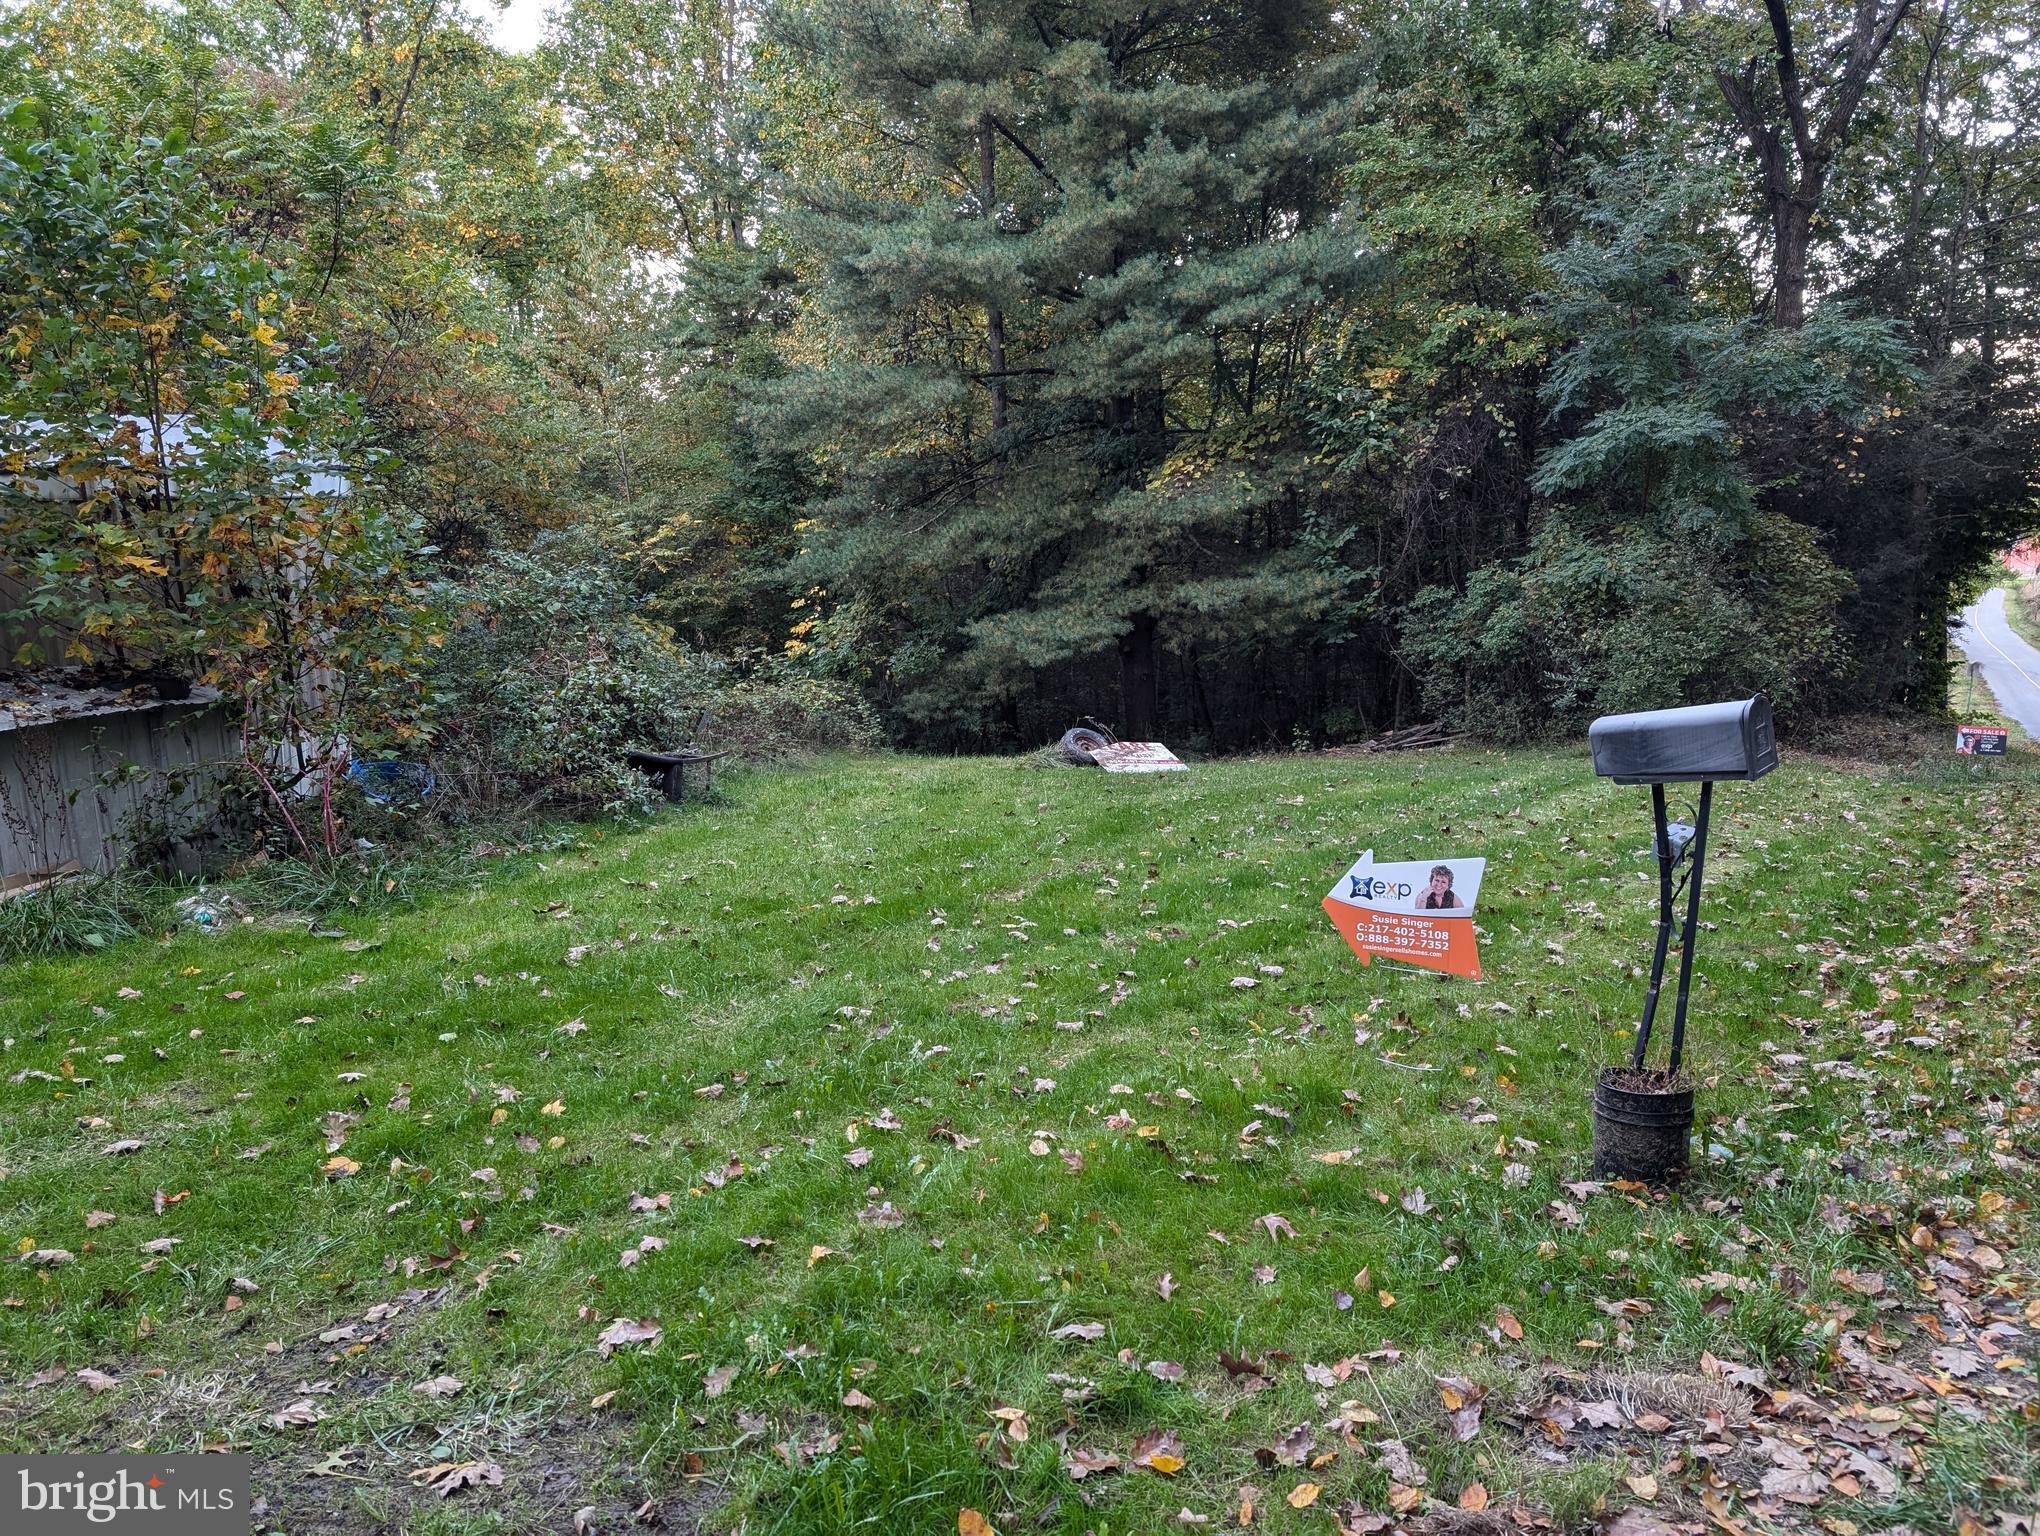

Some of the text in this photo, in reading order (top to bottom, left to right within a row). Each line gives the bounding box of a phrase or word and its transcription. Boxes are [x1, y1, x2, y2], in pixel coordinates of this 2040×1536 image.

[1373, 881, 1412, 900] exp
[1372, 914, 1434, 929] Susie Singer
[1357, 922, 1449, 941] C:217-402-5108
[1356, 932, 1449, 951] O:888-397-7352
